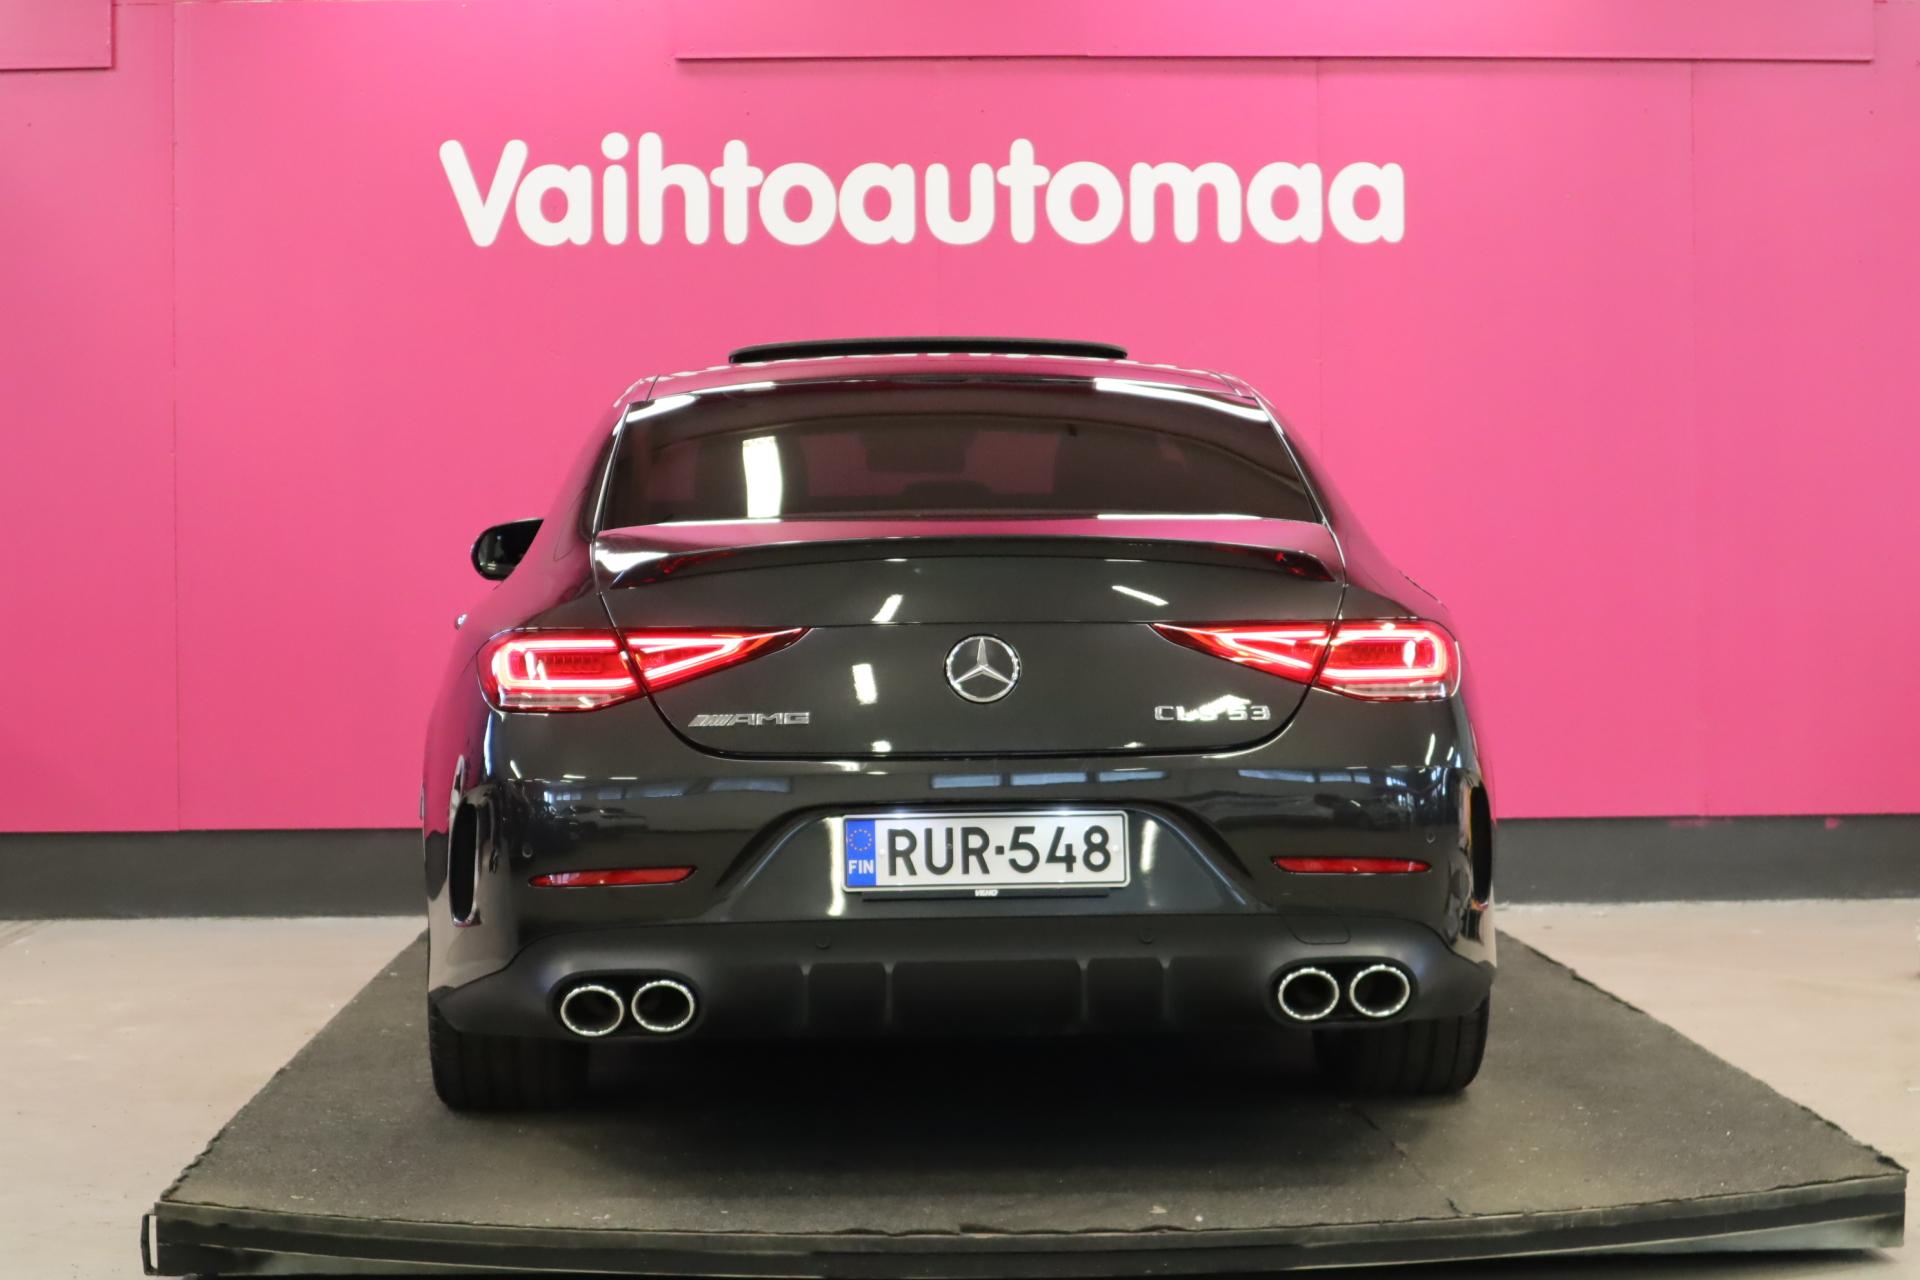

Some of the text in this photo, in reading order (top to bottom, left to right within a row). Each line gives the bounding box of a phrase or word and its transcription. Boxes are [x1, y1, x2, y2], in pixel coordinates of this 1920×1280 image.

[439, 132, 1405, 247] Vaihtoautomaa
[1226, 705, 1271, 721] 53
[848, 859, 874, 874] FIN
